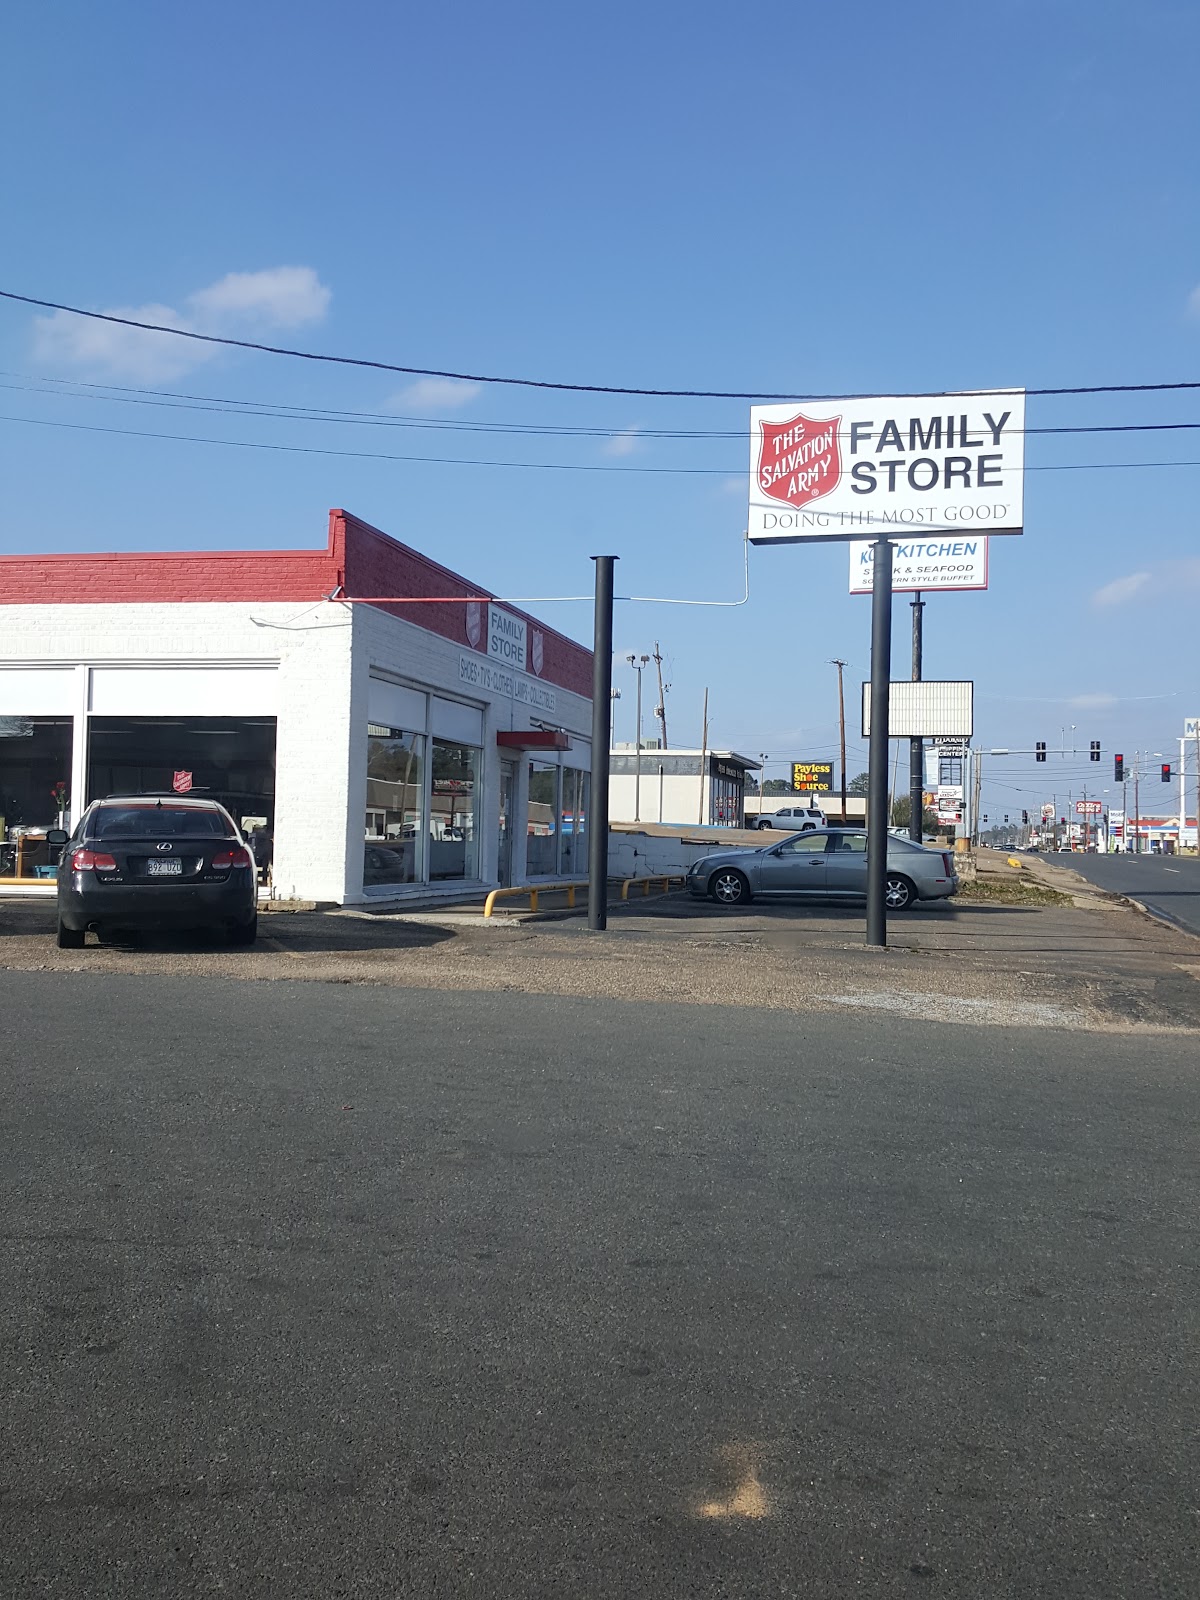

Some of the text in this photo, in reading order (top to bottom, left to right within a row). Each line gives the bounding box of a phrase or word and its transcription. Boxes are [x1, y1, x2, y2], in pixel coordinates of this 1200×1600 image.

[773, 423, 805, 455] THE
[850, 411, 1012, 454] FAMILY
[761, 426, 833, 488] SALVATION
[787, 454, 831, 498] ARMY
[850, 454, 1004, 494] STORE
[763, 504, 1008, 530] DOING THE MOST GOOD
[896, 542, 977, 558] KITCHEN
[862, 574, 975, 585] SOERN STYLE BUFFET
[916, 564, 974, 573] SEAFOOD
[491, 612, 524, 641] FAMILY
[491, 634, 524, 663] STORE
[460, 658, 478, 682] SHOES
[793, 773, 819, 781] Shoe
[794, 763, 830, 774] Payless
[793, 781, 829, 790] Source
